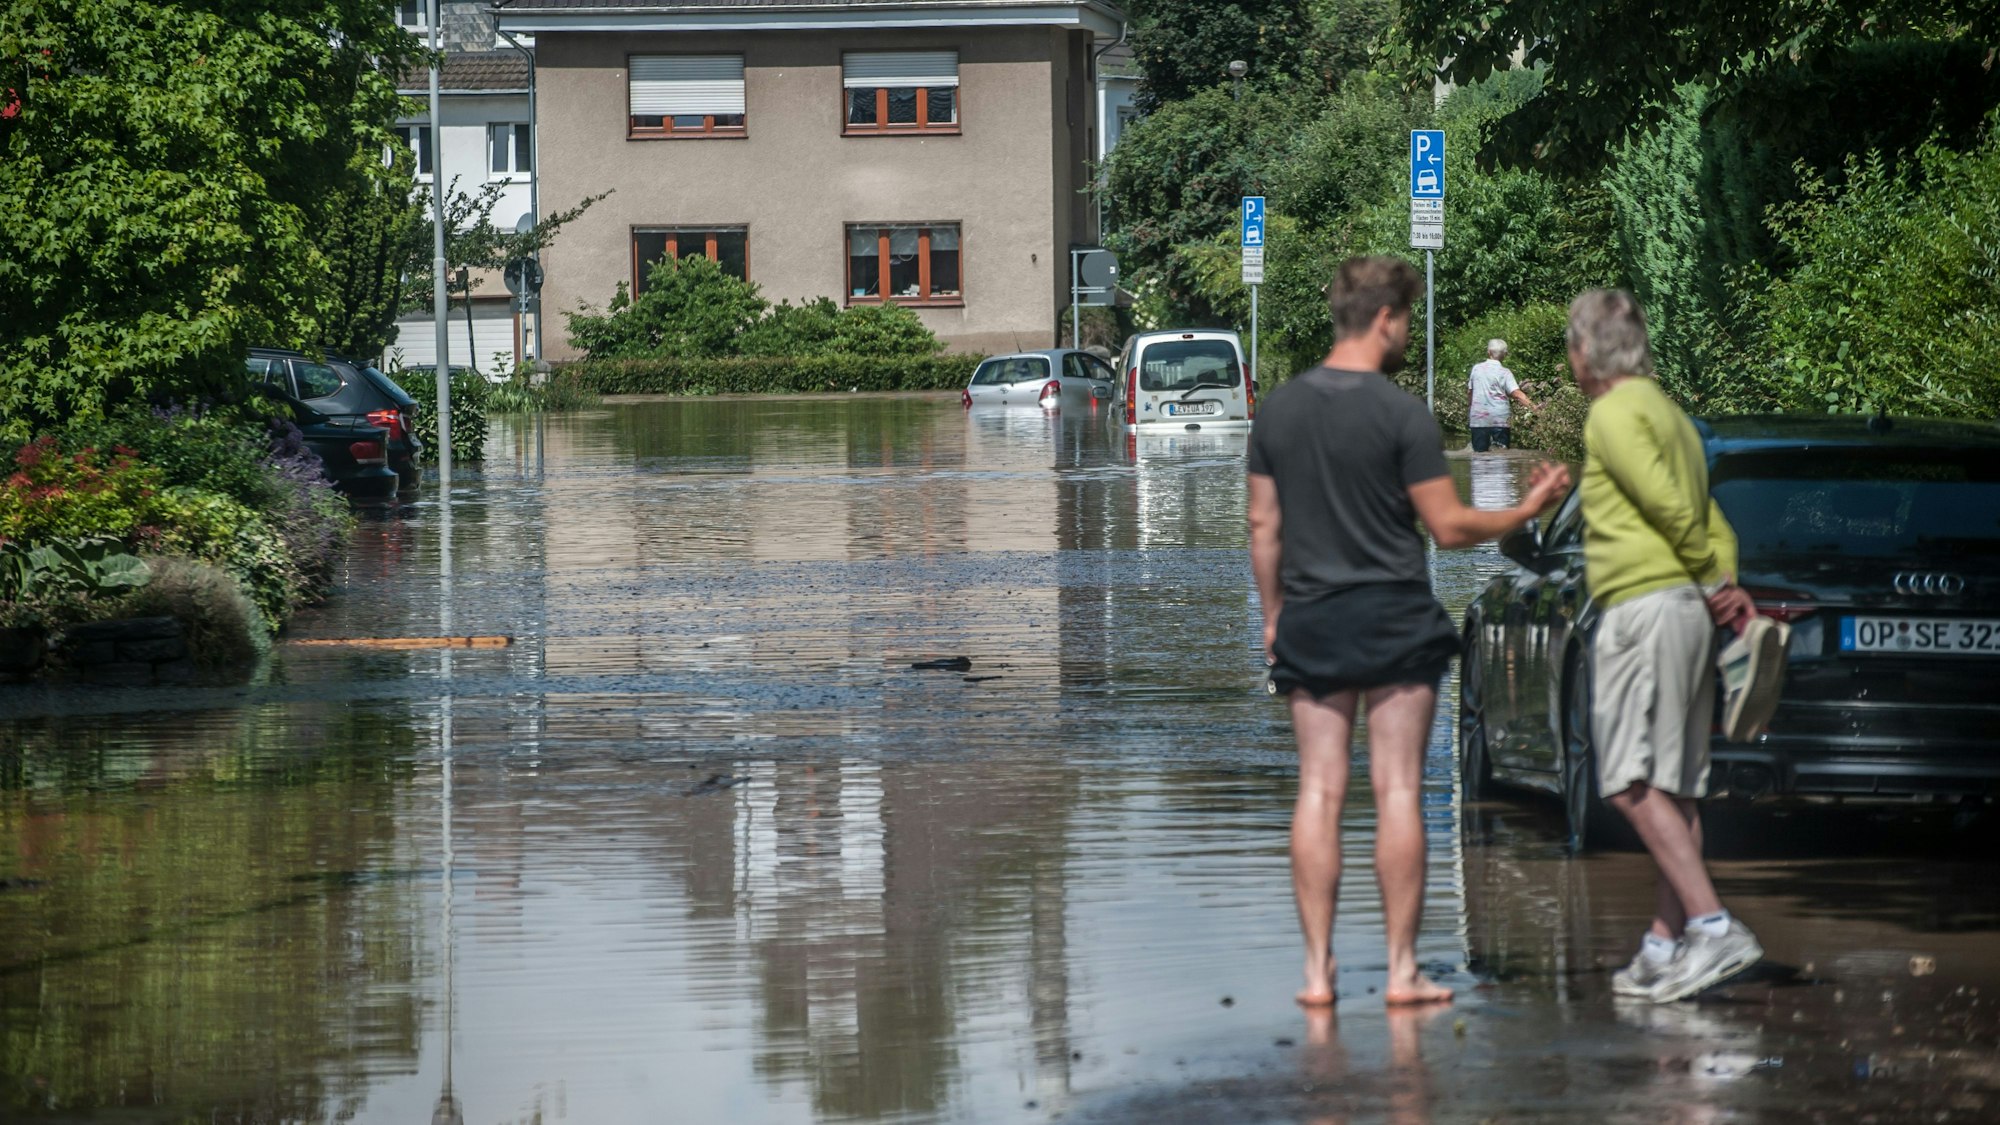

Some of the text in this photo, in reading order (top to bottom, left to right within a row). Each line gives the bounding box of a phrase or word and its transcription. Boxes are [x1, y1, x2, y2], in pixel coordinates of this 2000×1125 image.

[1417, 135, 1431, 161] P
[1246, 201, 1256, 220] P
[1859, 621, 1895, 647] OP
[1915, 622, 1951, 648] SE
